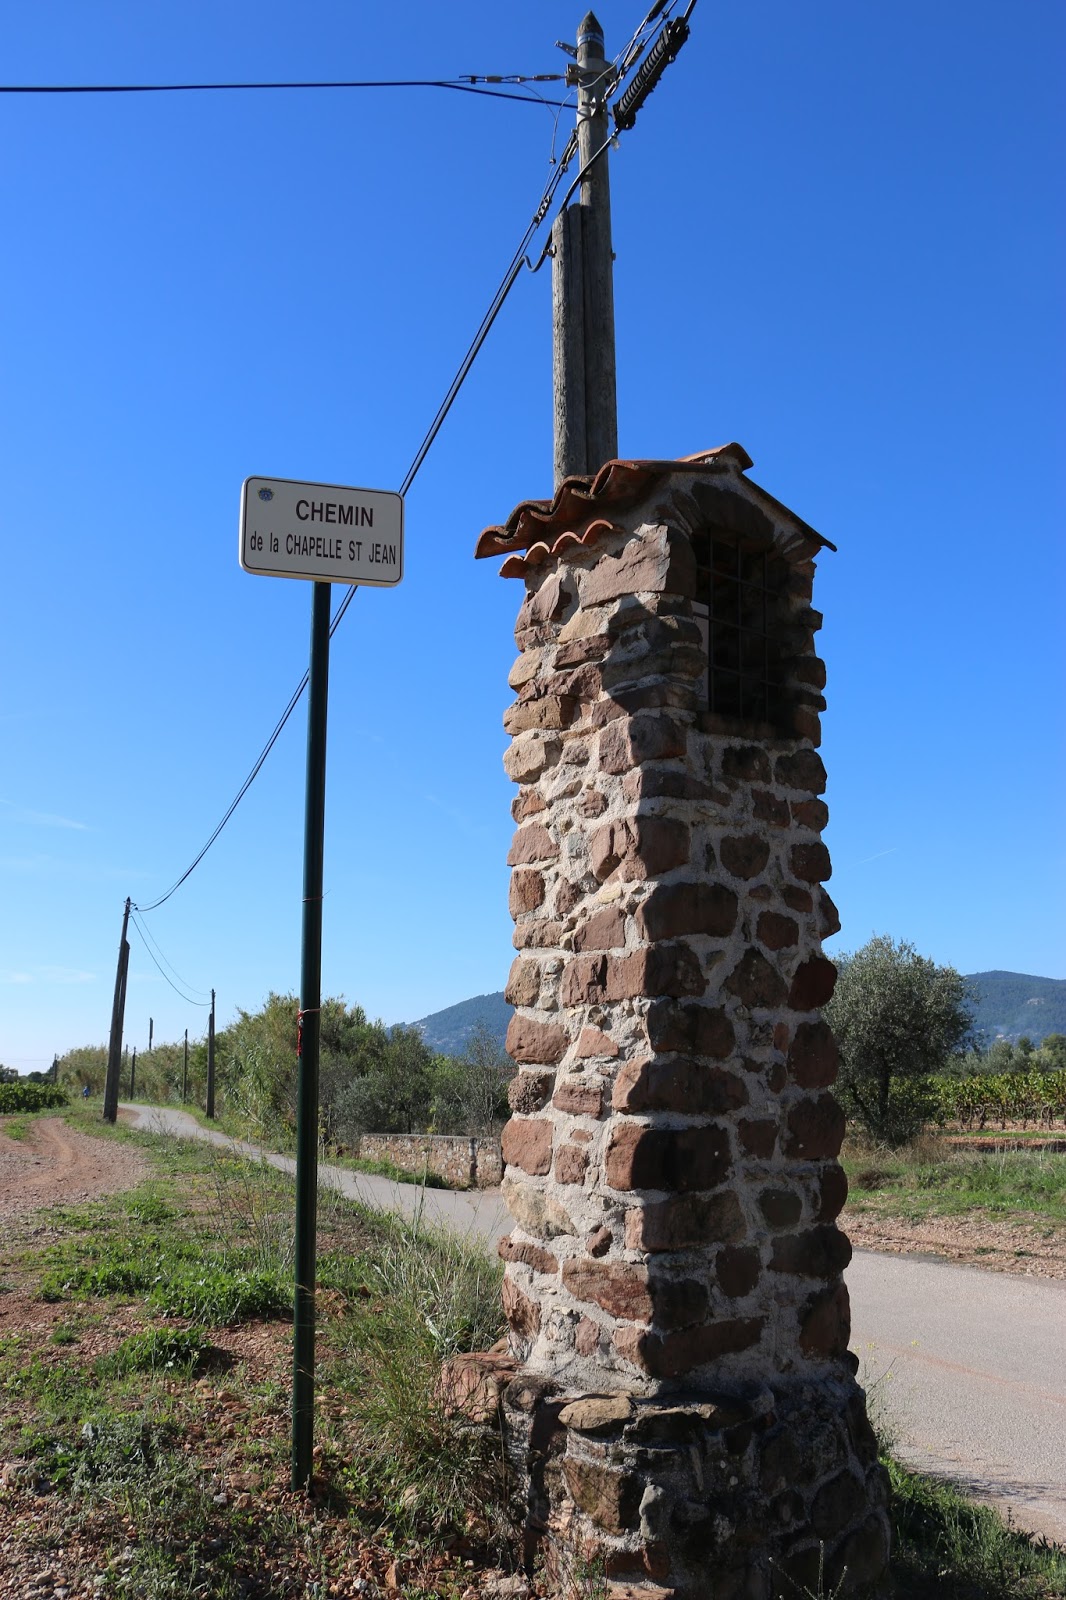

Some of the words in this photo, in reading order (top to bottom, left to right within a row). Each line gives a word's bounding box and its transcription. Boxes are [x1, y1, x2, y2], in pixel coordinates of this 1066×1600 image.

[295, 499, 374, 527] CHEMIN
[250, 531, 263, 551] de
[270, 532, 279, 553] la
[286, 533, 342, 559] CHAPELLE
[348, 540, 362, 561] ST
[368, 543, 396, 565] JEAN
